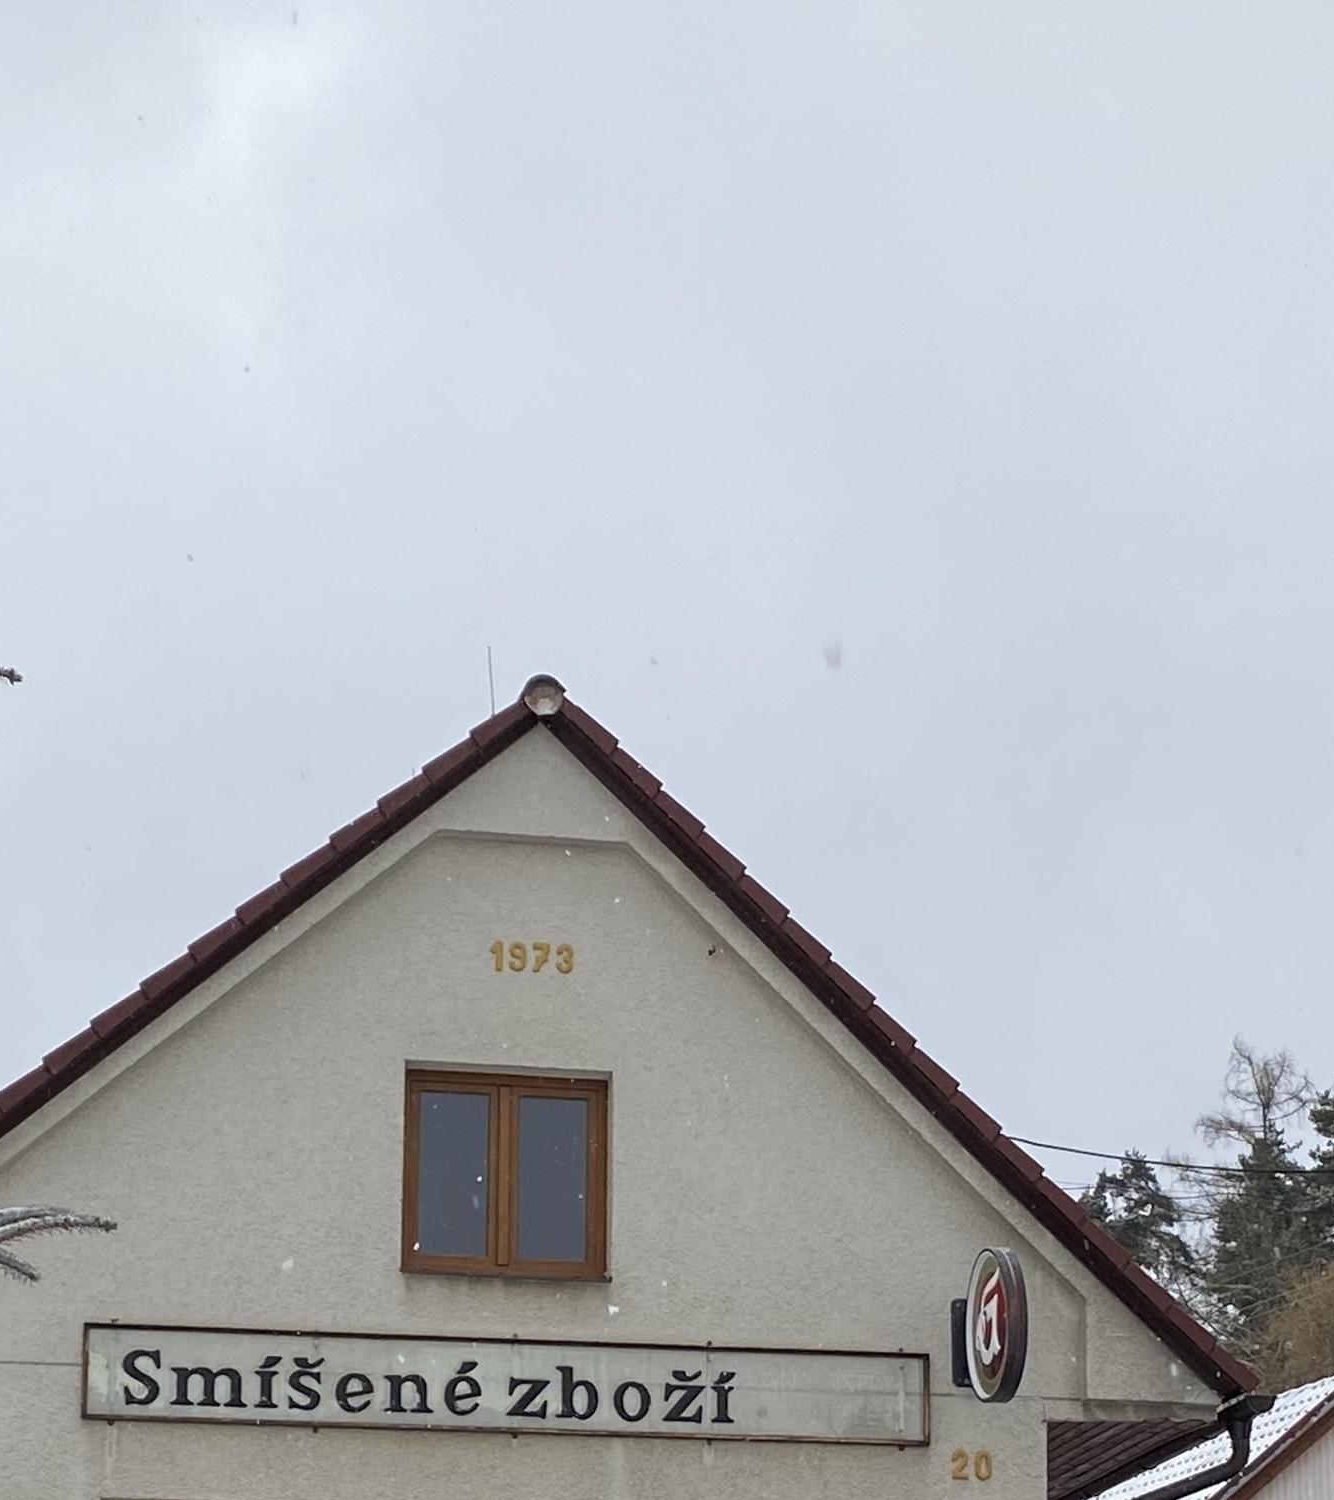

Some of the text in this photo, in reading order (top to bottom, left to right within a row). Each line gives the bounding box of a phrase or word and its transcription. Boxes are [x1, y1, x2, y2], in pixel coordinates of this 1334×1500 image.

[490, 940, 574, 975] 1973
[122, 1350, 736, 1424] Smíšené zboží
[951, 1450, 992, 1481] 20
